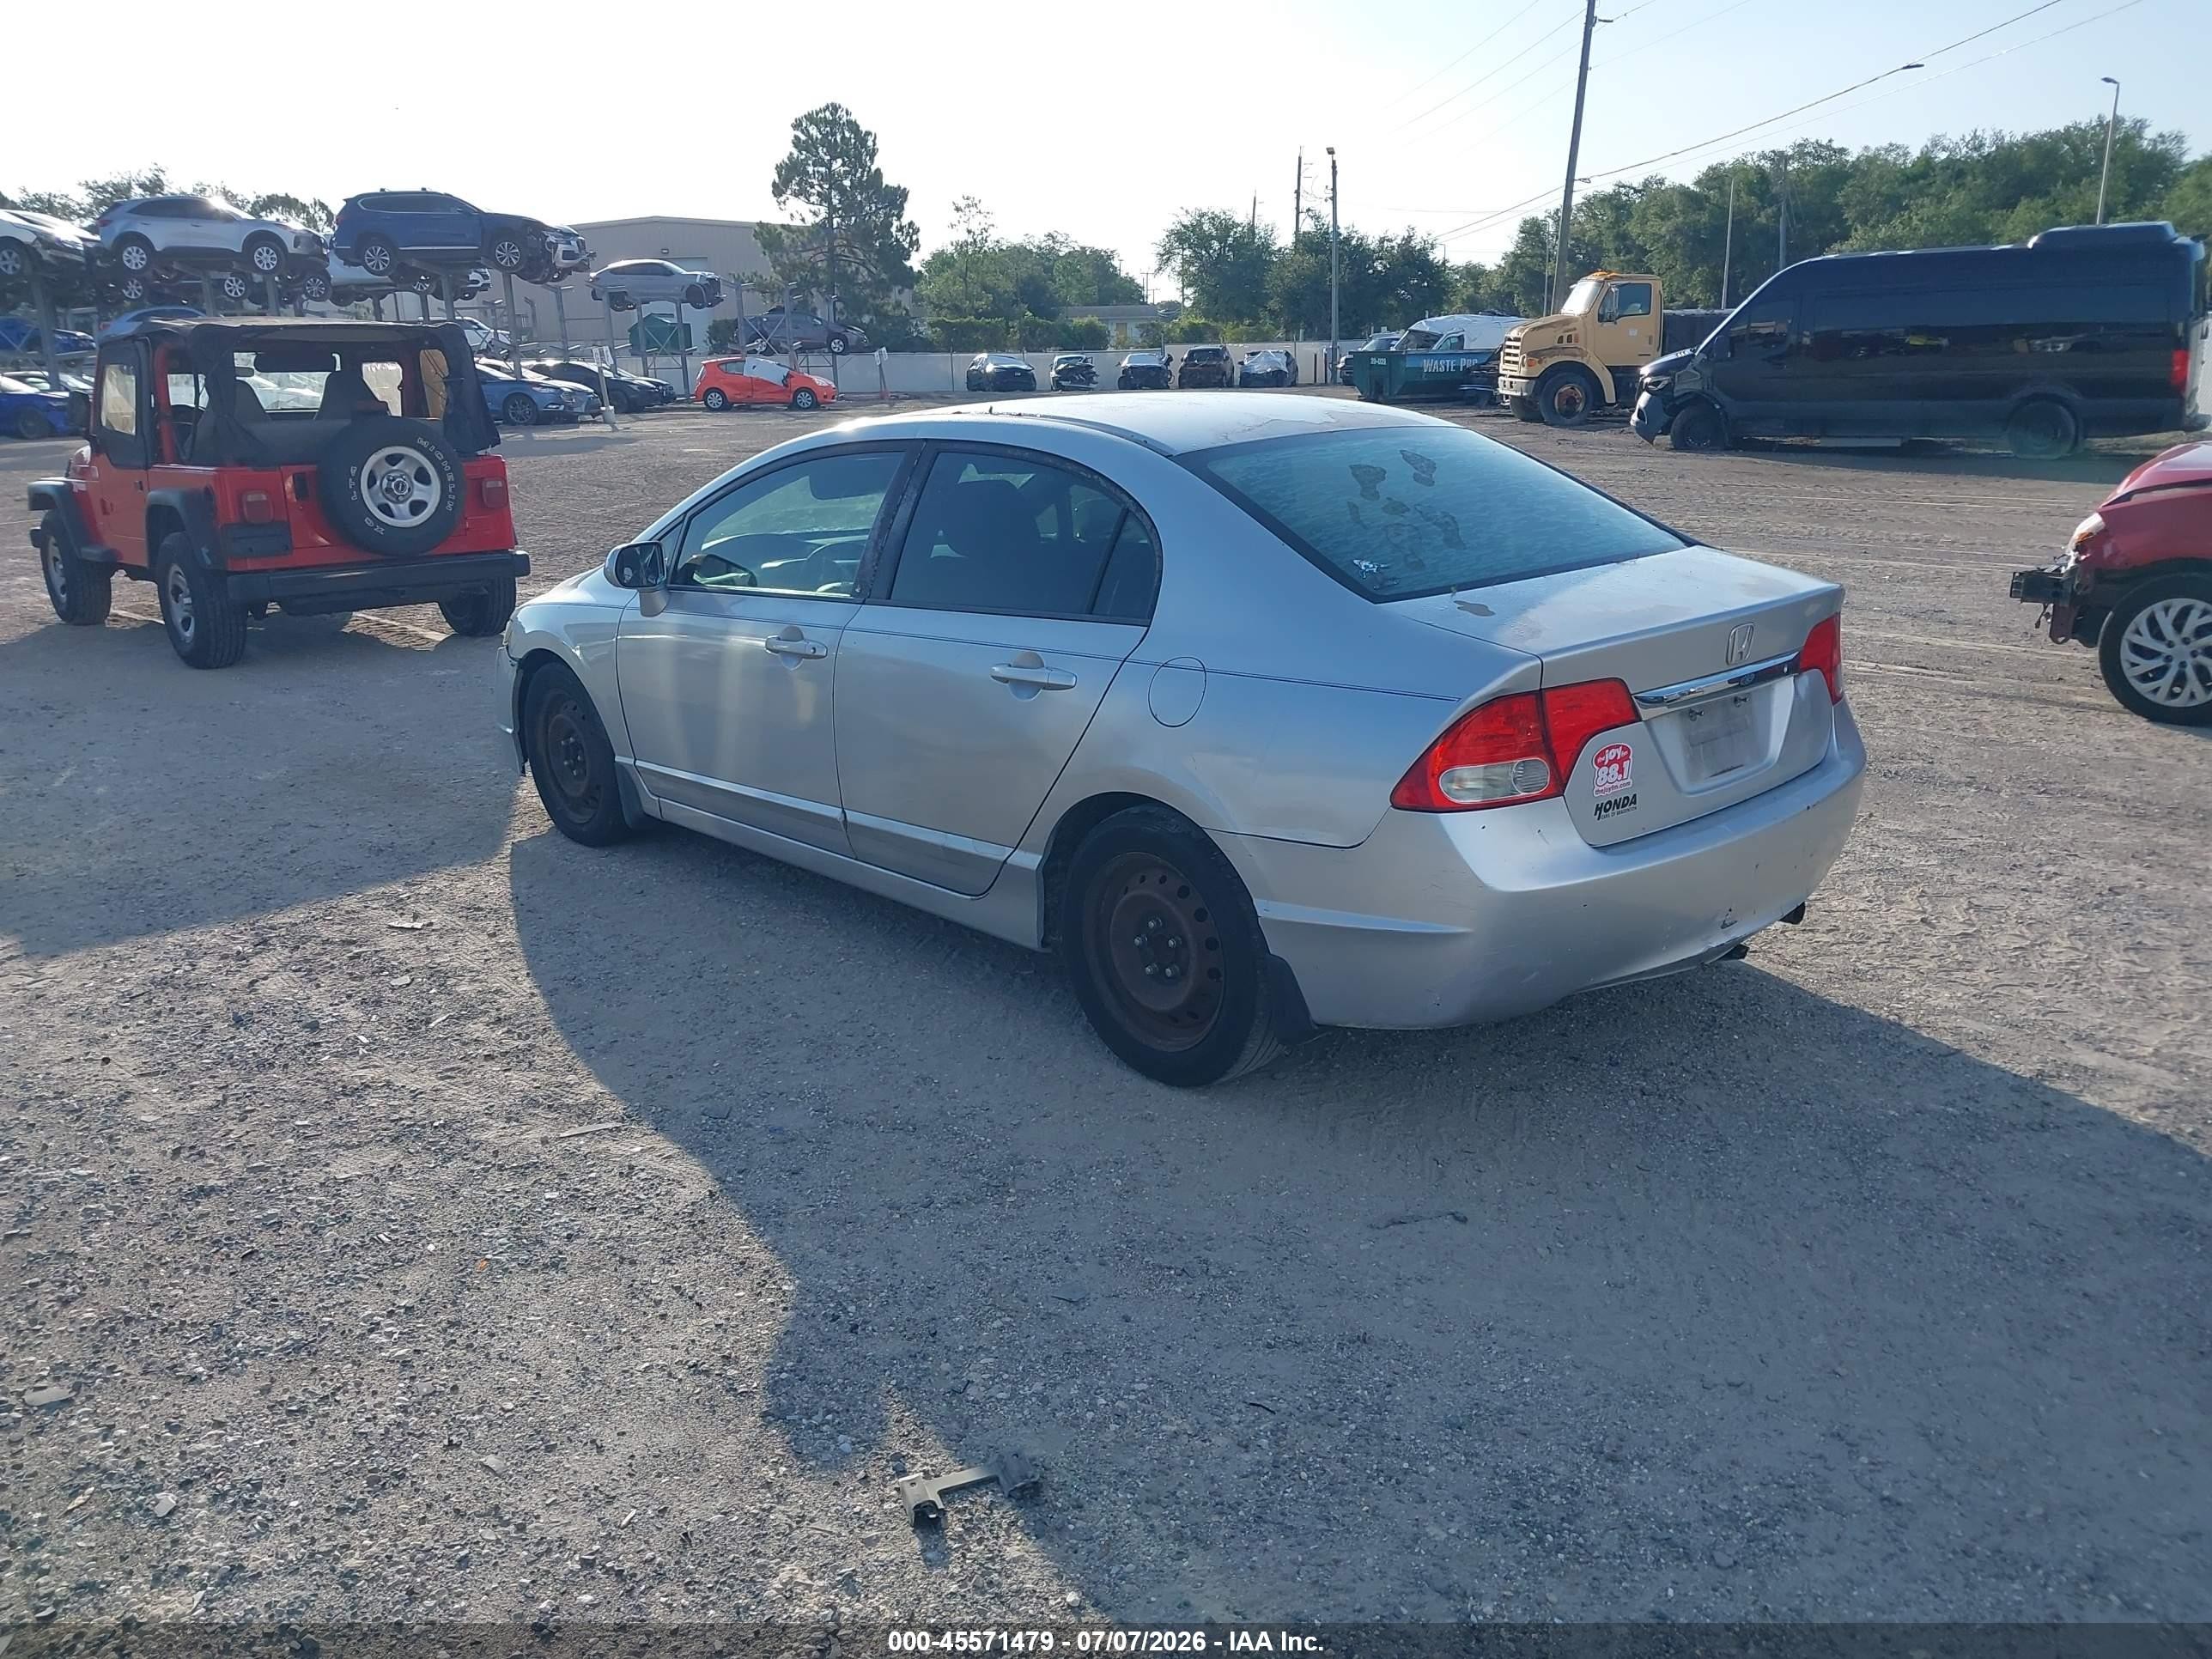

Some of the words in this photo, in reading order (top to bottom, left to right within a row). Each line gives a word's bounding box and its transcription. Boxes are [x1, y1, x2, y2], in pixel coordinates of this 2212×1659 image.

[1423, 358, 1456, 373] WASTE
[416, 437, 456, 512] MICHELIN
[1596, 759, 1630, 786] 88.1
[1595, 781, 1632, 795] thejoyfm.com
[1594, 793, 1637, 821] HONDA
